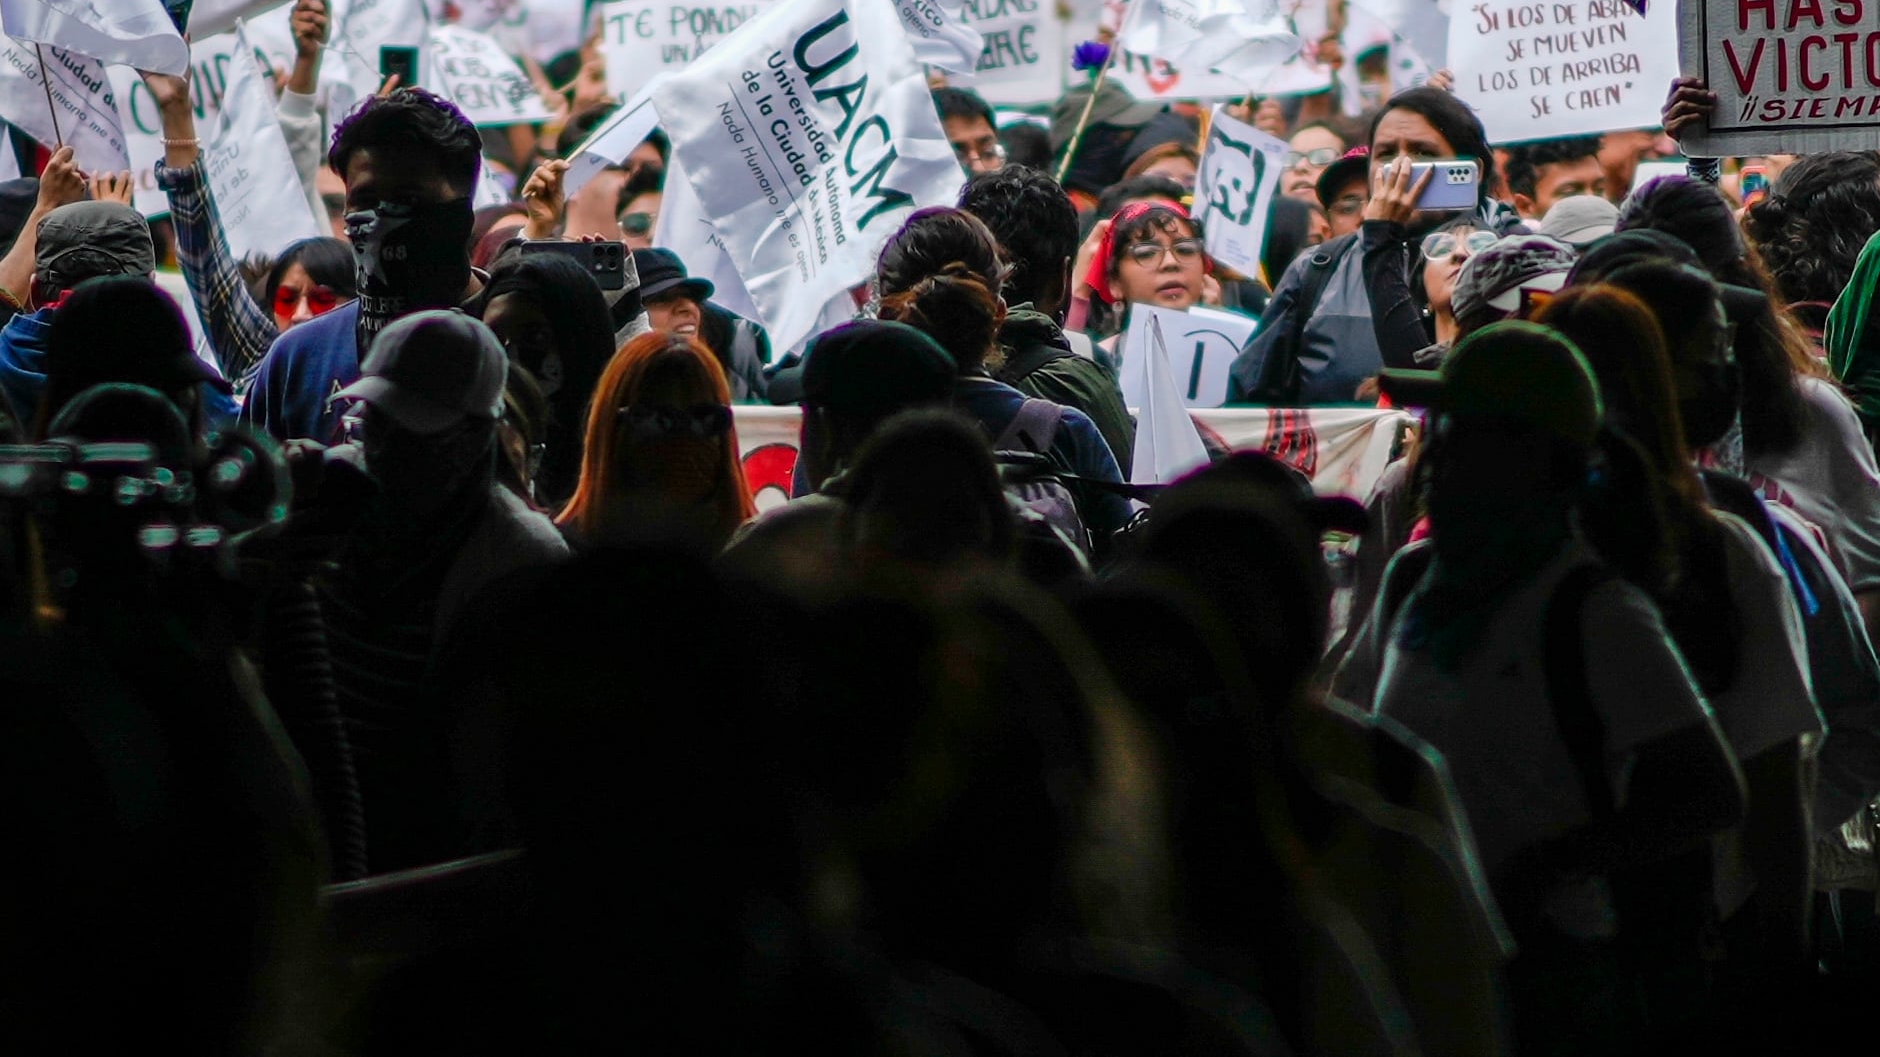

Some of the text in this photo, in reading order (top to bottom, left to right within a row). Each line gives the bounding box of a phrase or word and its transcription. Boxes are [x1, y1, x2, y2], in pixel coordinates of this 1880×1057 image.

[1507, 3, 1546, 29] LOS
[1553, 3, 1577, 26] DE
[2, 47, 38, 81] Nada
[1505, 21, 1628, 63] SE MUEVEN
[51, 45, 106, 95] Ciudad
[1478, 52, 1641, 94] LOS DE ARRIBA
[741, 69, 762, 95] de
[755, 94, 774, 117] la
[770, 118, 816, 188] Ciudad
[793, 7, 917, 234] UACM
[1530, 94, 1552, 120] SE
[716, 100, 745, 145] Nada
[739, 145, 780, 207] Humano
[767, 49, 847, 247] Universidad Autónoma
